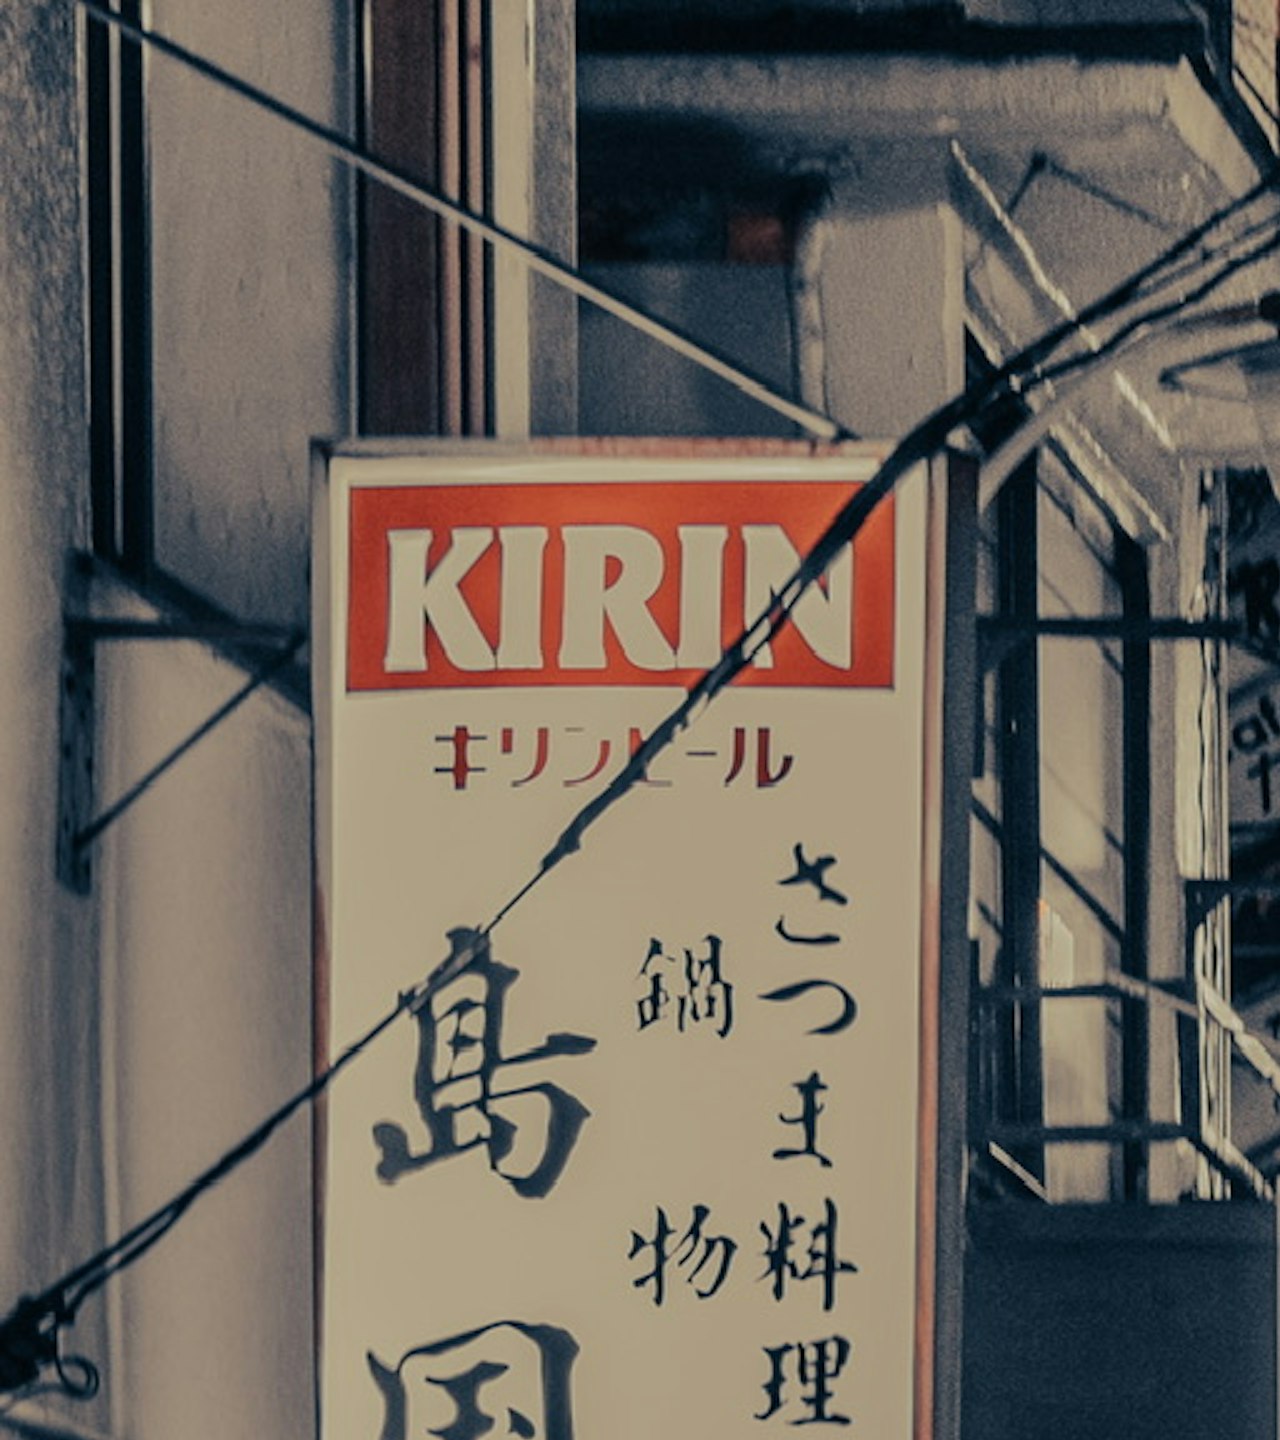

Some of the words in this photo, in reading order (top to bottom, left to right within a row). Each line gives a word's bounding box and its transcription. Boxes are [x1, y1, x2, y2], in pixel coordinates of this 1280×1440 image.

[383, 523, 855, 673] KIRIN
[754, 843, 858, 1427] さつま料理
